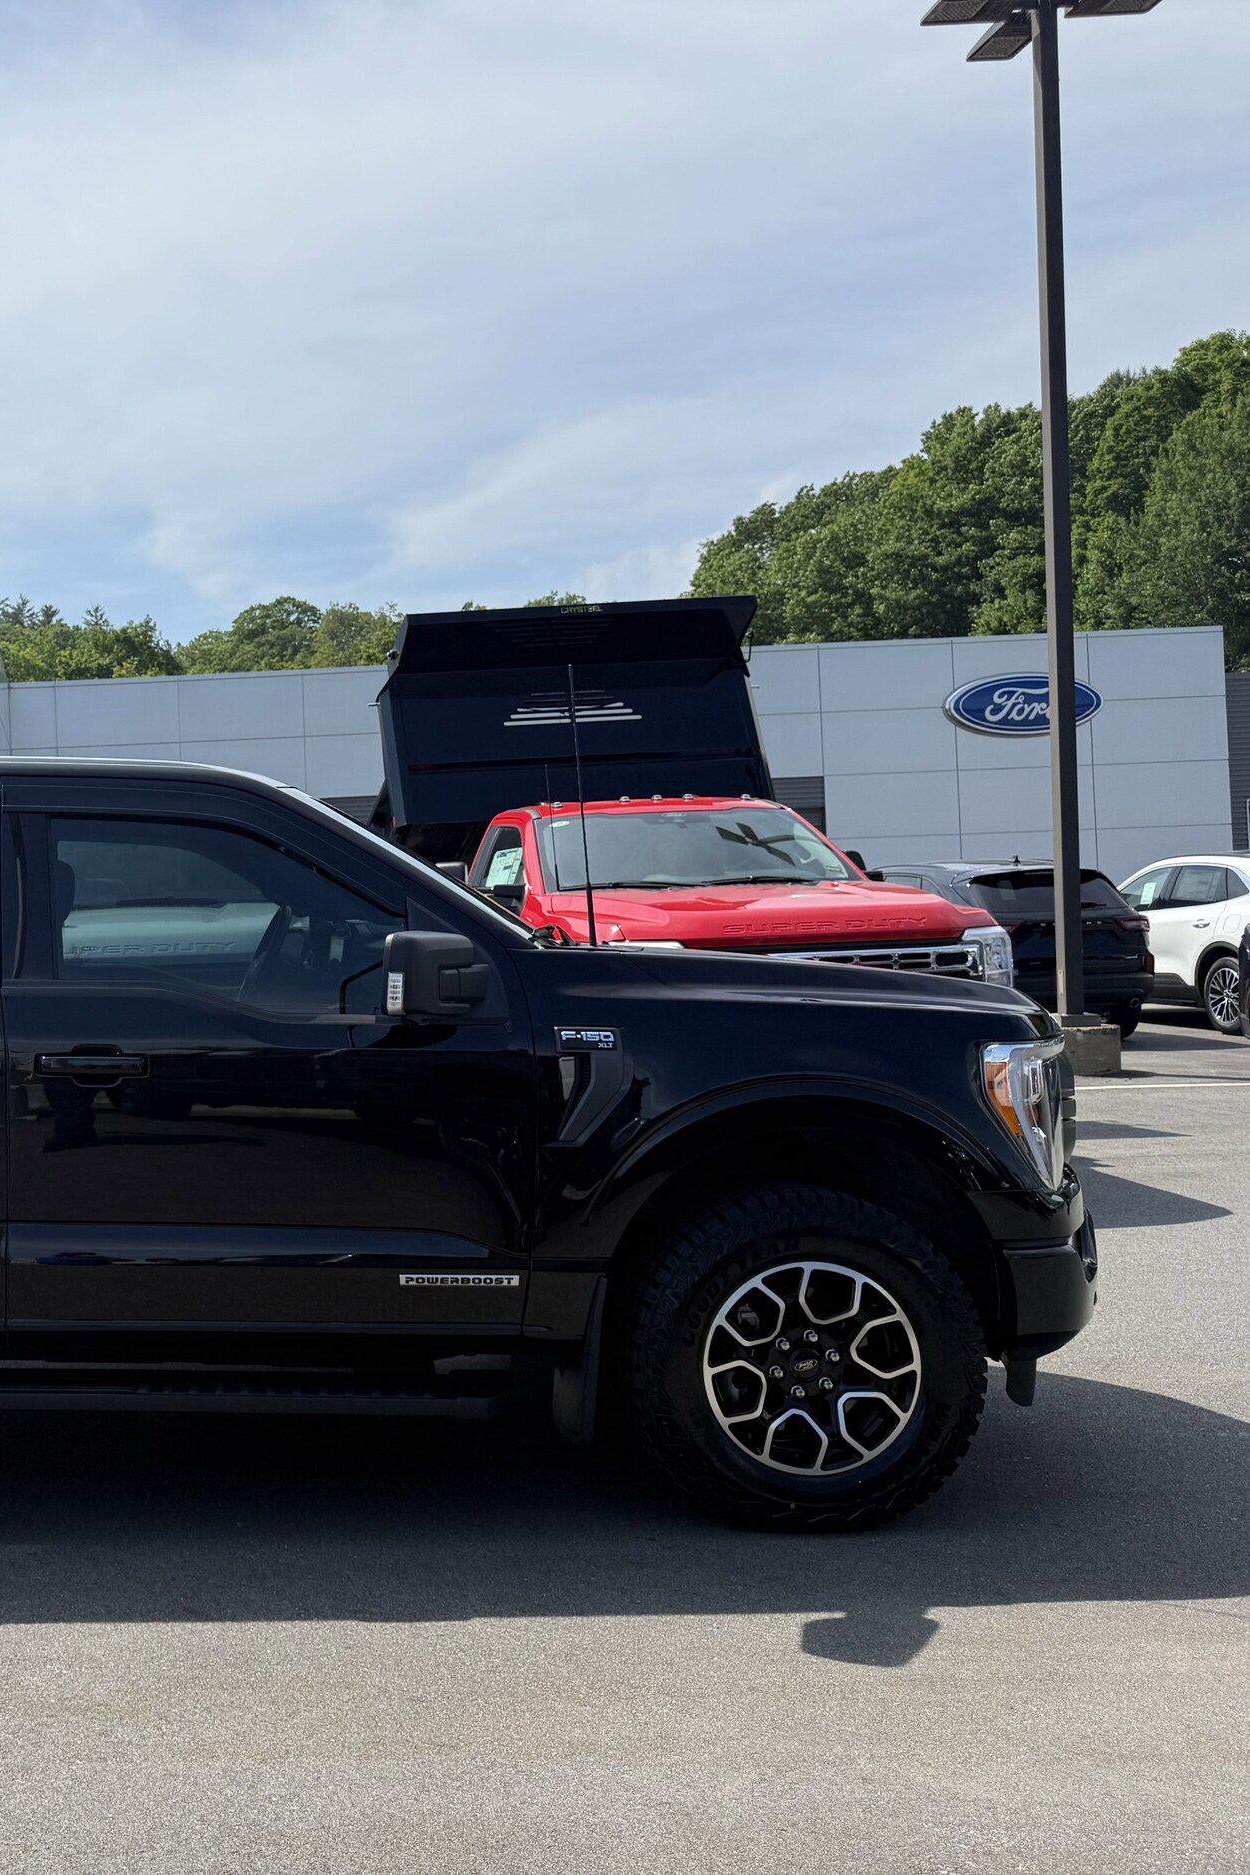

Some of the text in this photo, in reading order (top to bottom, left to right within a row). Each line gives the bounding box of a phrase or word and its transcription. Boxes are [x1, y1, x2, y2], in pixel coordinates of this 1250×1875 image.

[984, 687, 1051, 722] For
[723, 916, 927, 935] SUPER DUTY
[63, 941, 236, 956] UPER DUTY
[560, 1031, 615, 1042] F-150
[404, 1276, 514, 1285] POWERBOOST
